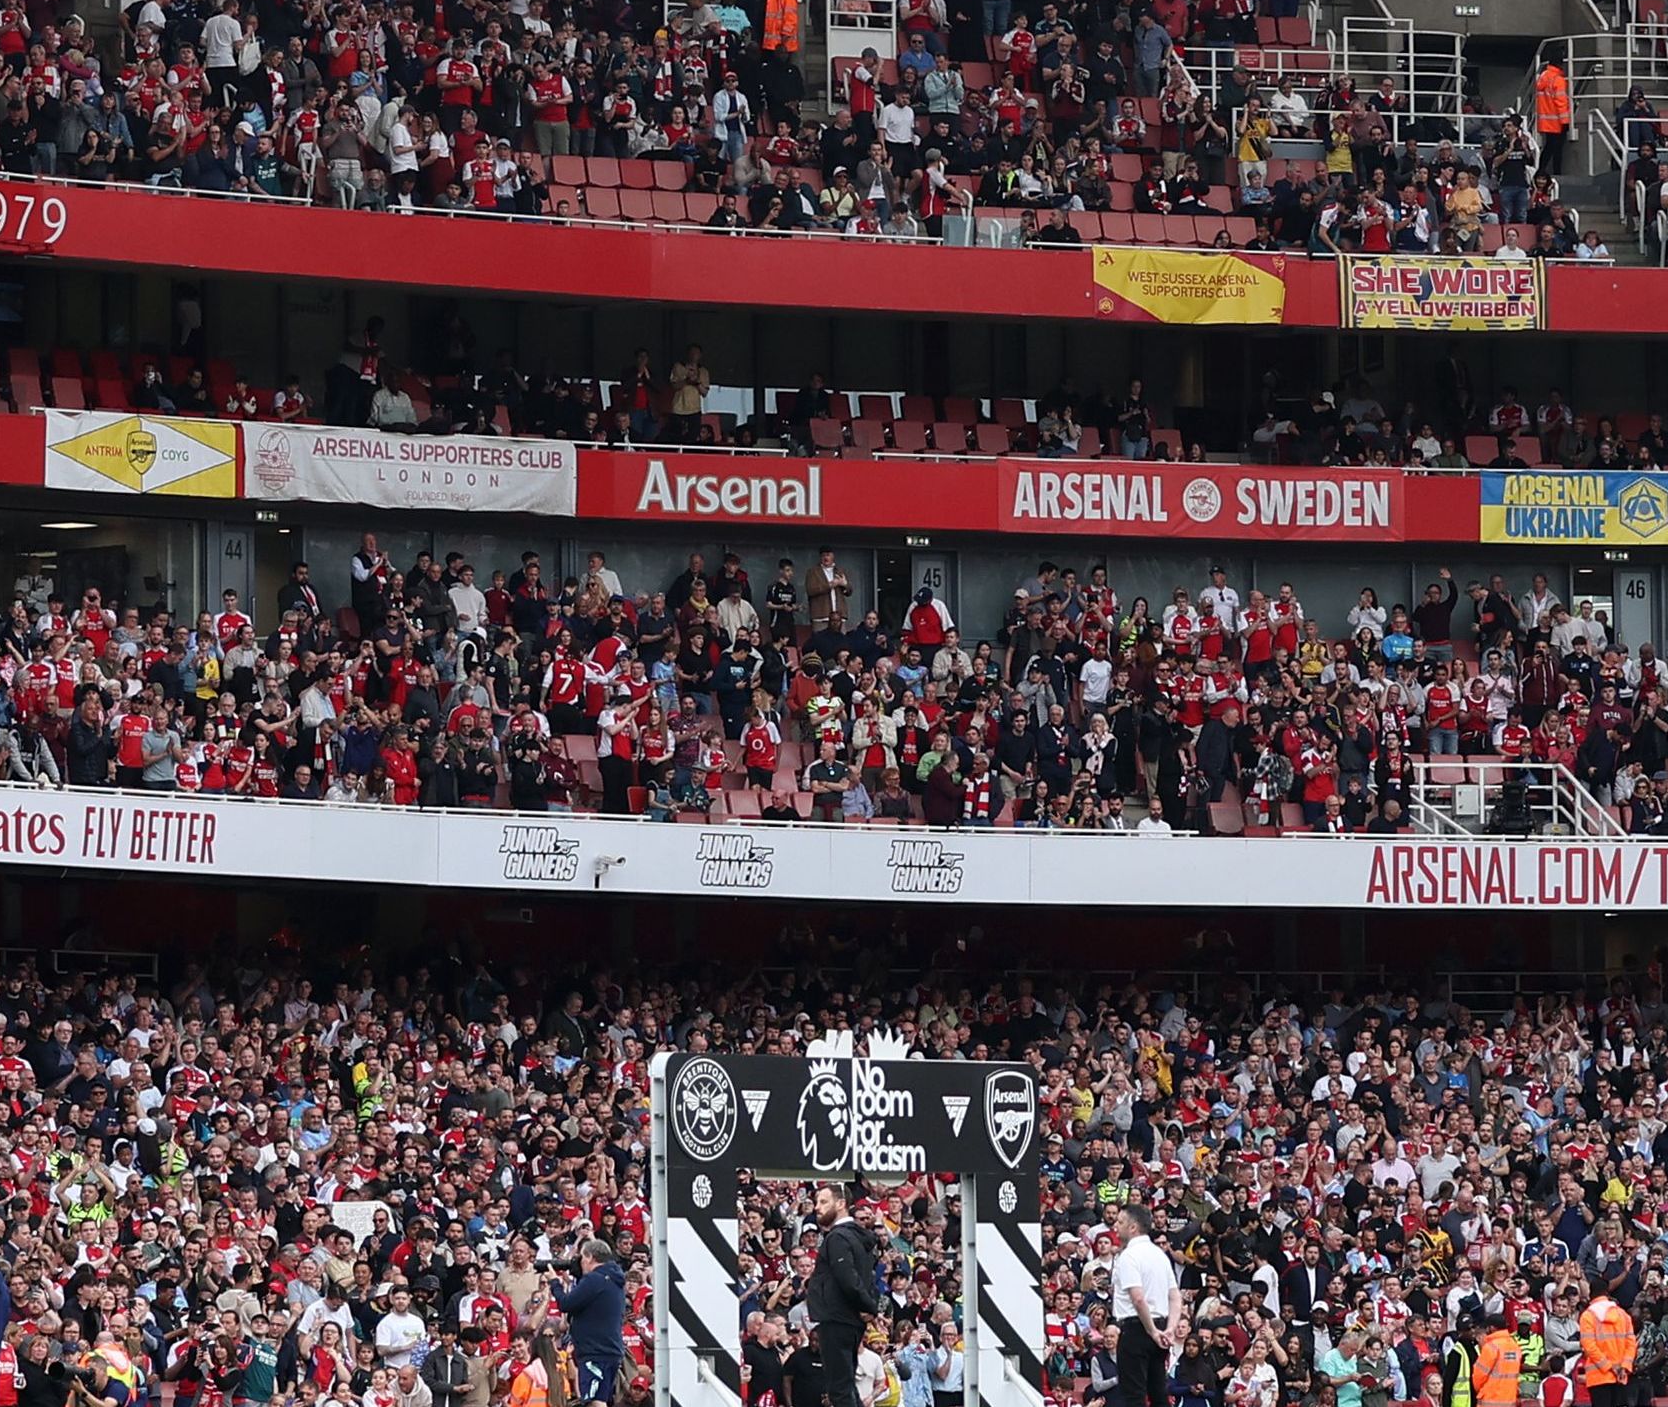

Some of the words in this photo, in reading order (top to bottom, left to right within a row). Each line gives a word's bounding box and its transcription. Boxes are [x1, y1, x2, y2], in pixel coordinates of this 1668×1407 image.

[1127, 271, 1161, 284] WEST
[1160, 272, 1207, 285] SUSSEX
[1208, 273, 1260, 286] ARSENAL
[1142, 284, 1215, 299] SUPPORTERS
[1215, 287, 1246, 298] CLUB
[1353, 266, 1422, 295] SHE
[1429, 267, 1533, 296] WORE
[1372, 299, 1453, 317] YELLOW
[1460, 300, 1536, 317] RIBBON
[84, 444, 123, 458] ANTRIM
[161, 448, 190, 462] COYG
[312, 436, 396, 461] ARSENAL
[399, 441, 514, 468] SUPPORTERS
[517, 448, 564, 470] CLUB
[636, 460, 823, 517] Arsenal
[1013, 471, 1168, 523] ARSENAL
[1236, 477, 1389, 527] SWEDEN
[1503, 474, 1609, 506] ARSENAL
[1505, 507, 1606, 538] UKRAINE
[224, 539, 242, 560] 44
[922, 566, 942, 588] 45
[1625, 578, 1645, 600] 46
[558, 672, 573, 694] 7
[82, 805, 123, 859] FLY
[130, 808, 217, 864] BETTER
[499, 825, 558, 855] JUNIOR
[695, 832, 753, 861] JUNIOR
[503, 852, 579, 881] GUNNERS
[886, 839, 943, 868] JUNIOR
[700, 859, 774, 888] GUNNERS
[891, 865, 965, 894] GUNNERS
[682, 1063, 728, 1090] BRENTFORD
[852, 1058, 885, 1092] No
[852, 1090, 913, 1117] room
[993, 1088, 1028, 1103] Arsenal
[682, 1129, 712, 1156] FOOTBALL
[713, 1132, 729, 1153] CLUB
[852, 1113, 885, 1146] for
[852, 1134, 926, 1172] racism
